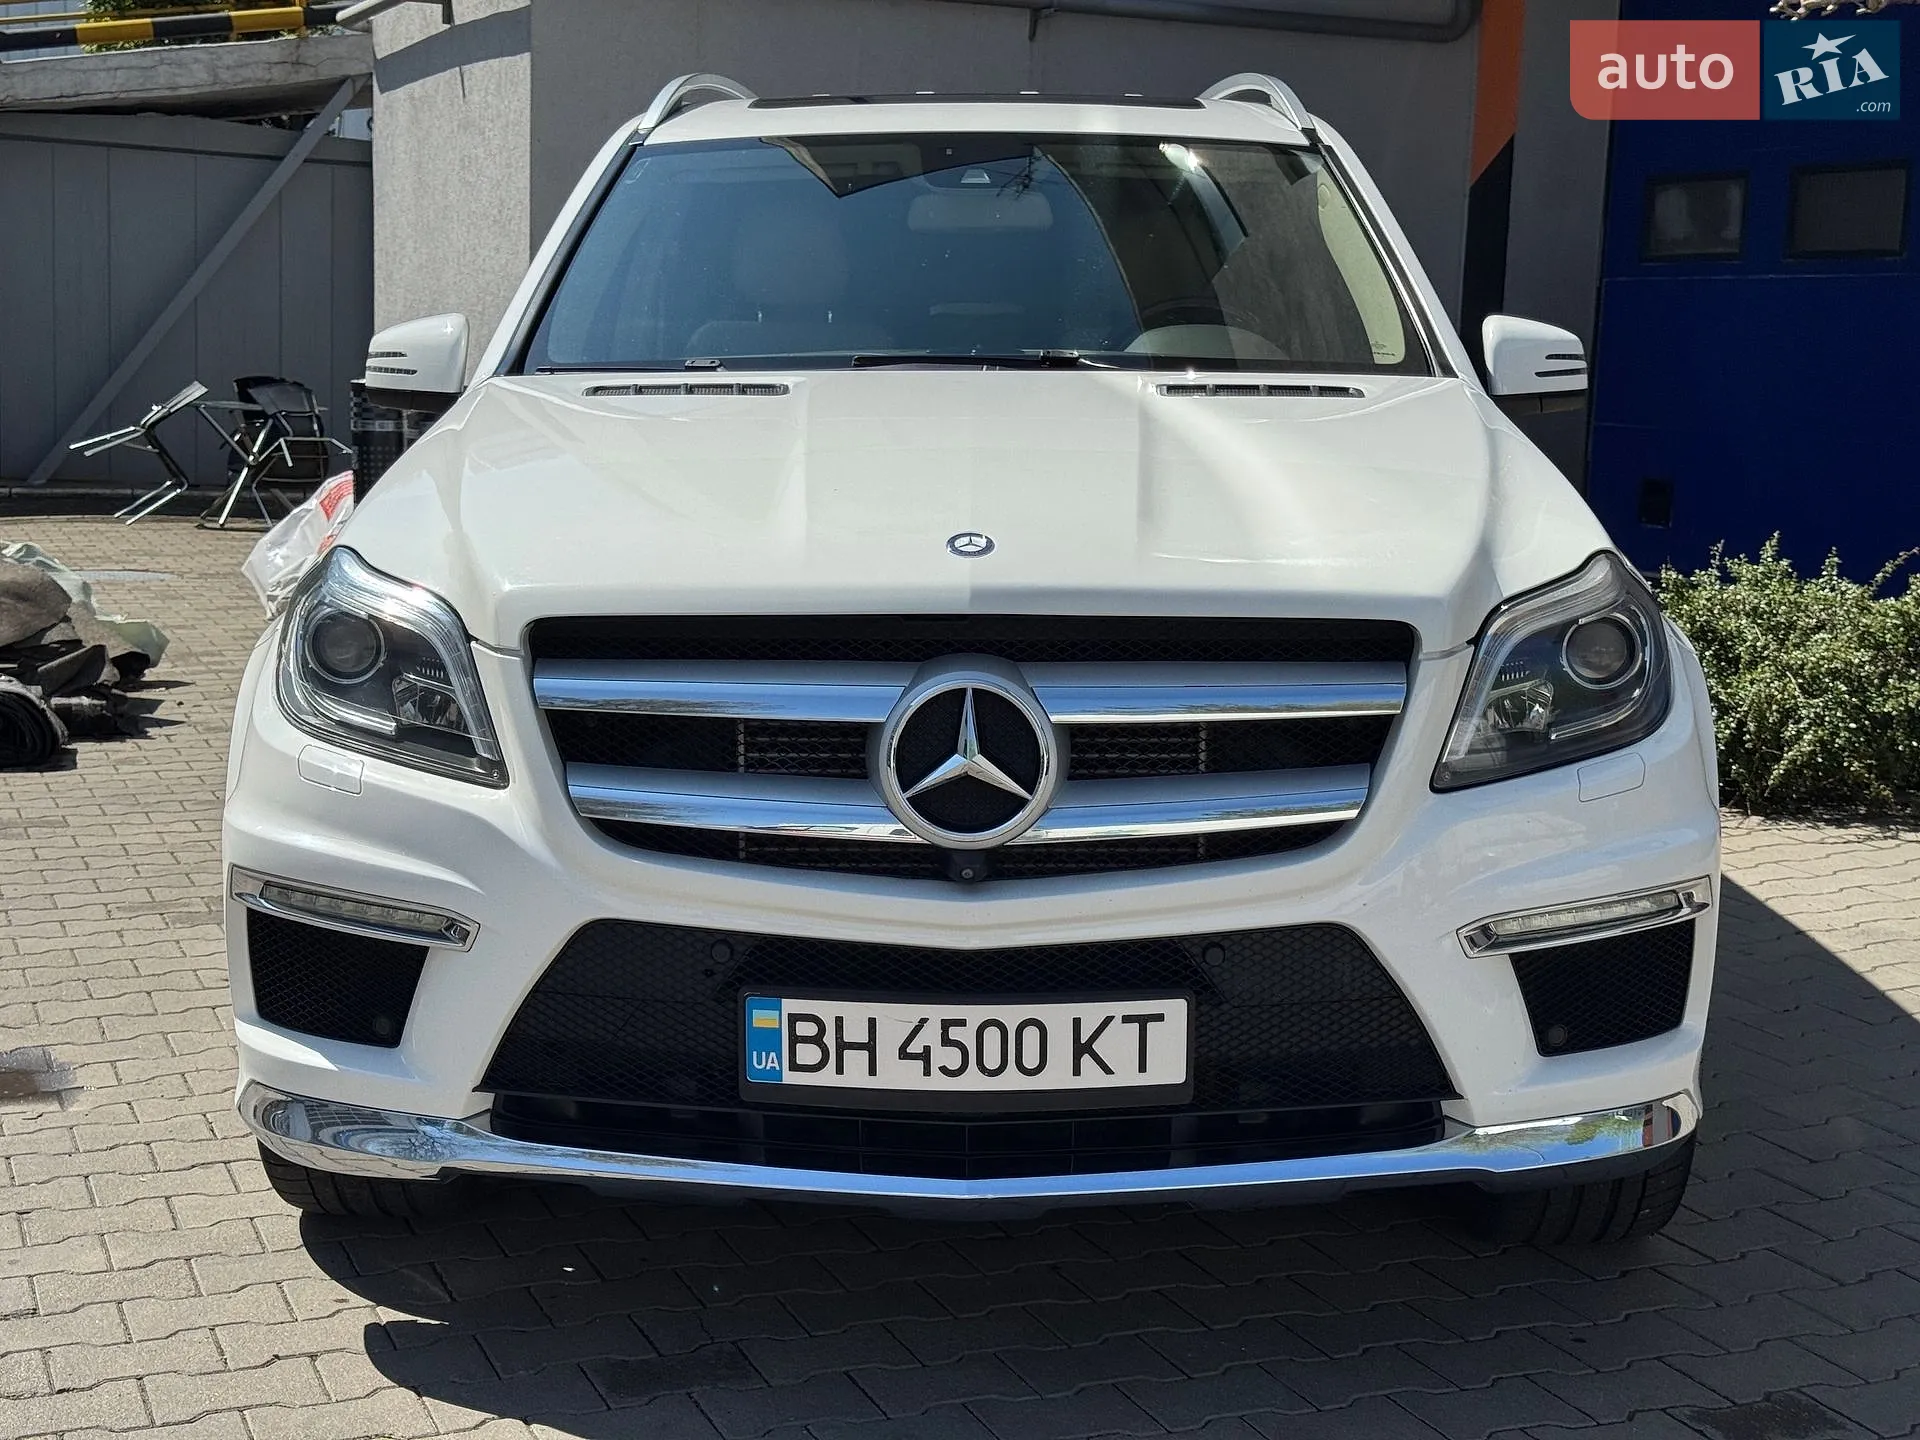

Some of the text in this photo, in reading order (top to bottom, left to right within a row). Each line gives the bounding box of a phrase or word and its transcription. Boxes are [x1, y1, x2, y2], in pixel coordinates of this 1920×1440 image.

[752, 1051, 780, 1071] UA
[787, 1012, 1165, 1078] BH 4500 KT
